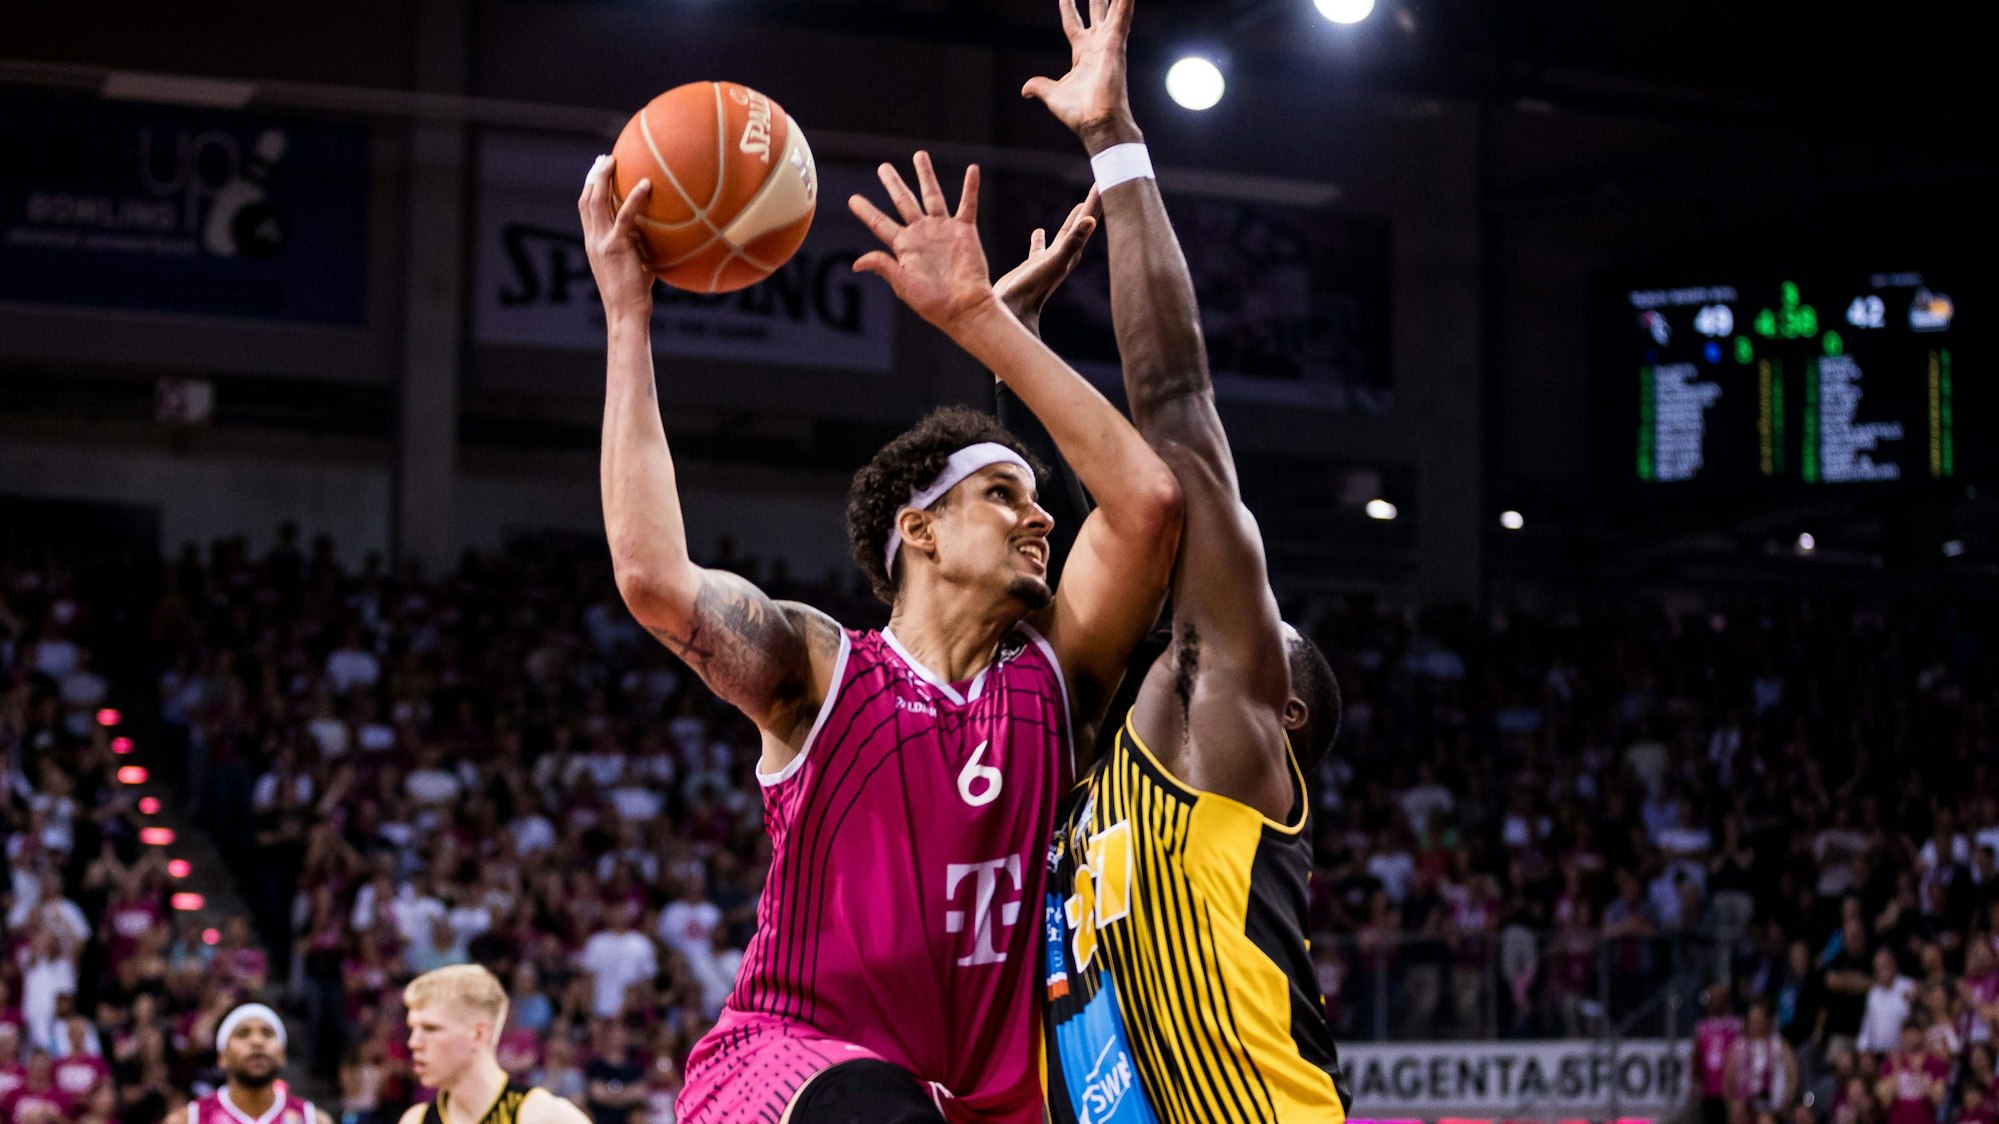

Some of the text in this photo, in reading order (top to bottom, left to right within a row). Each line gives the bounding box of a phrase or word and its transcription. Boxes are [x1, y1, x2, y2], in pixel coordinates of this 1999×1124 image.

[498, 222, 863, 335] SPNG
[957, 740, 1003, 807] 6
[946, 853, 1022, 967] T
